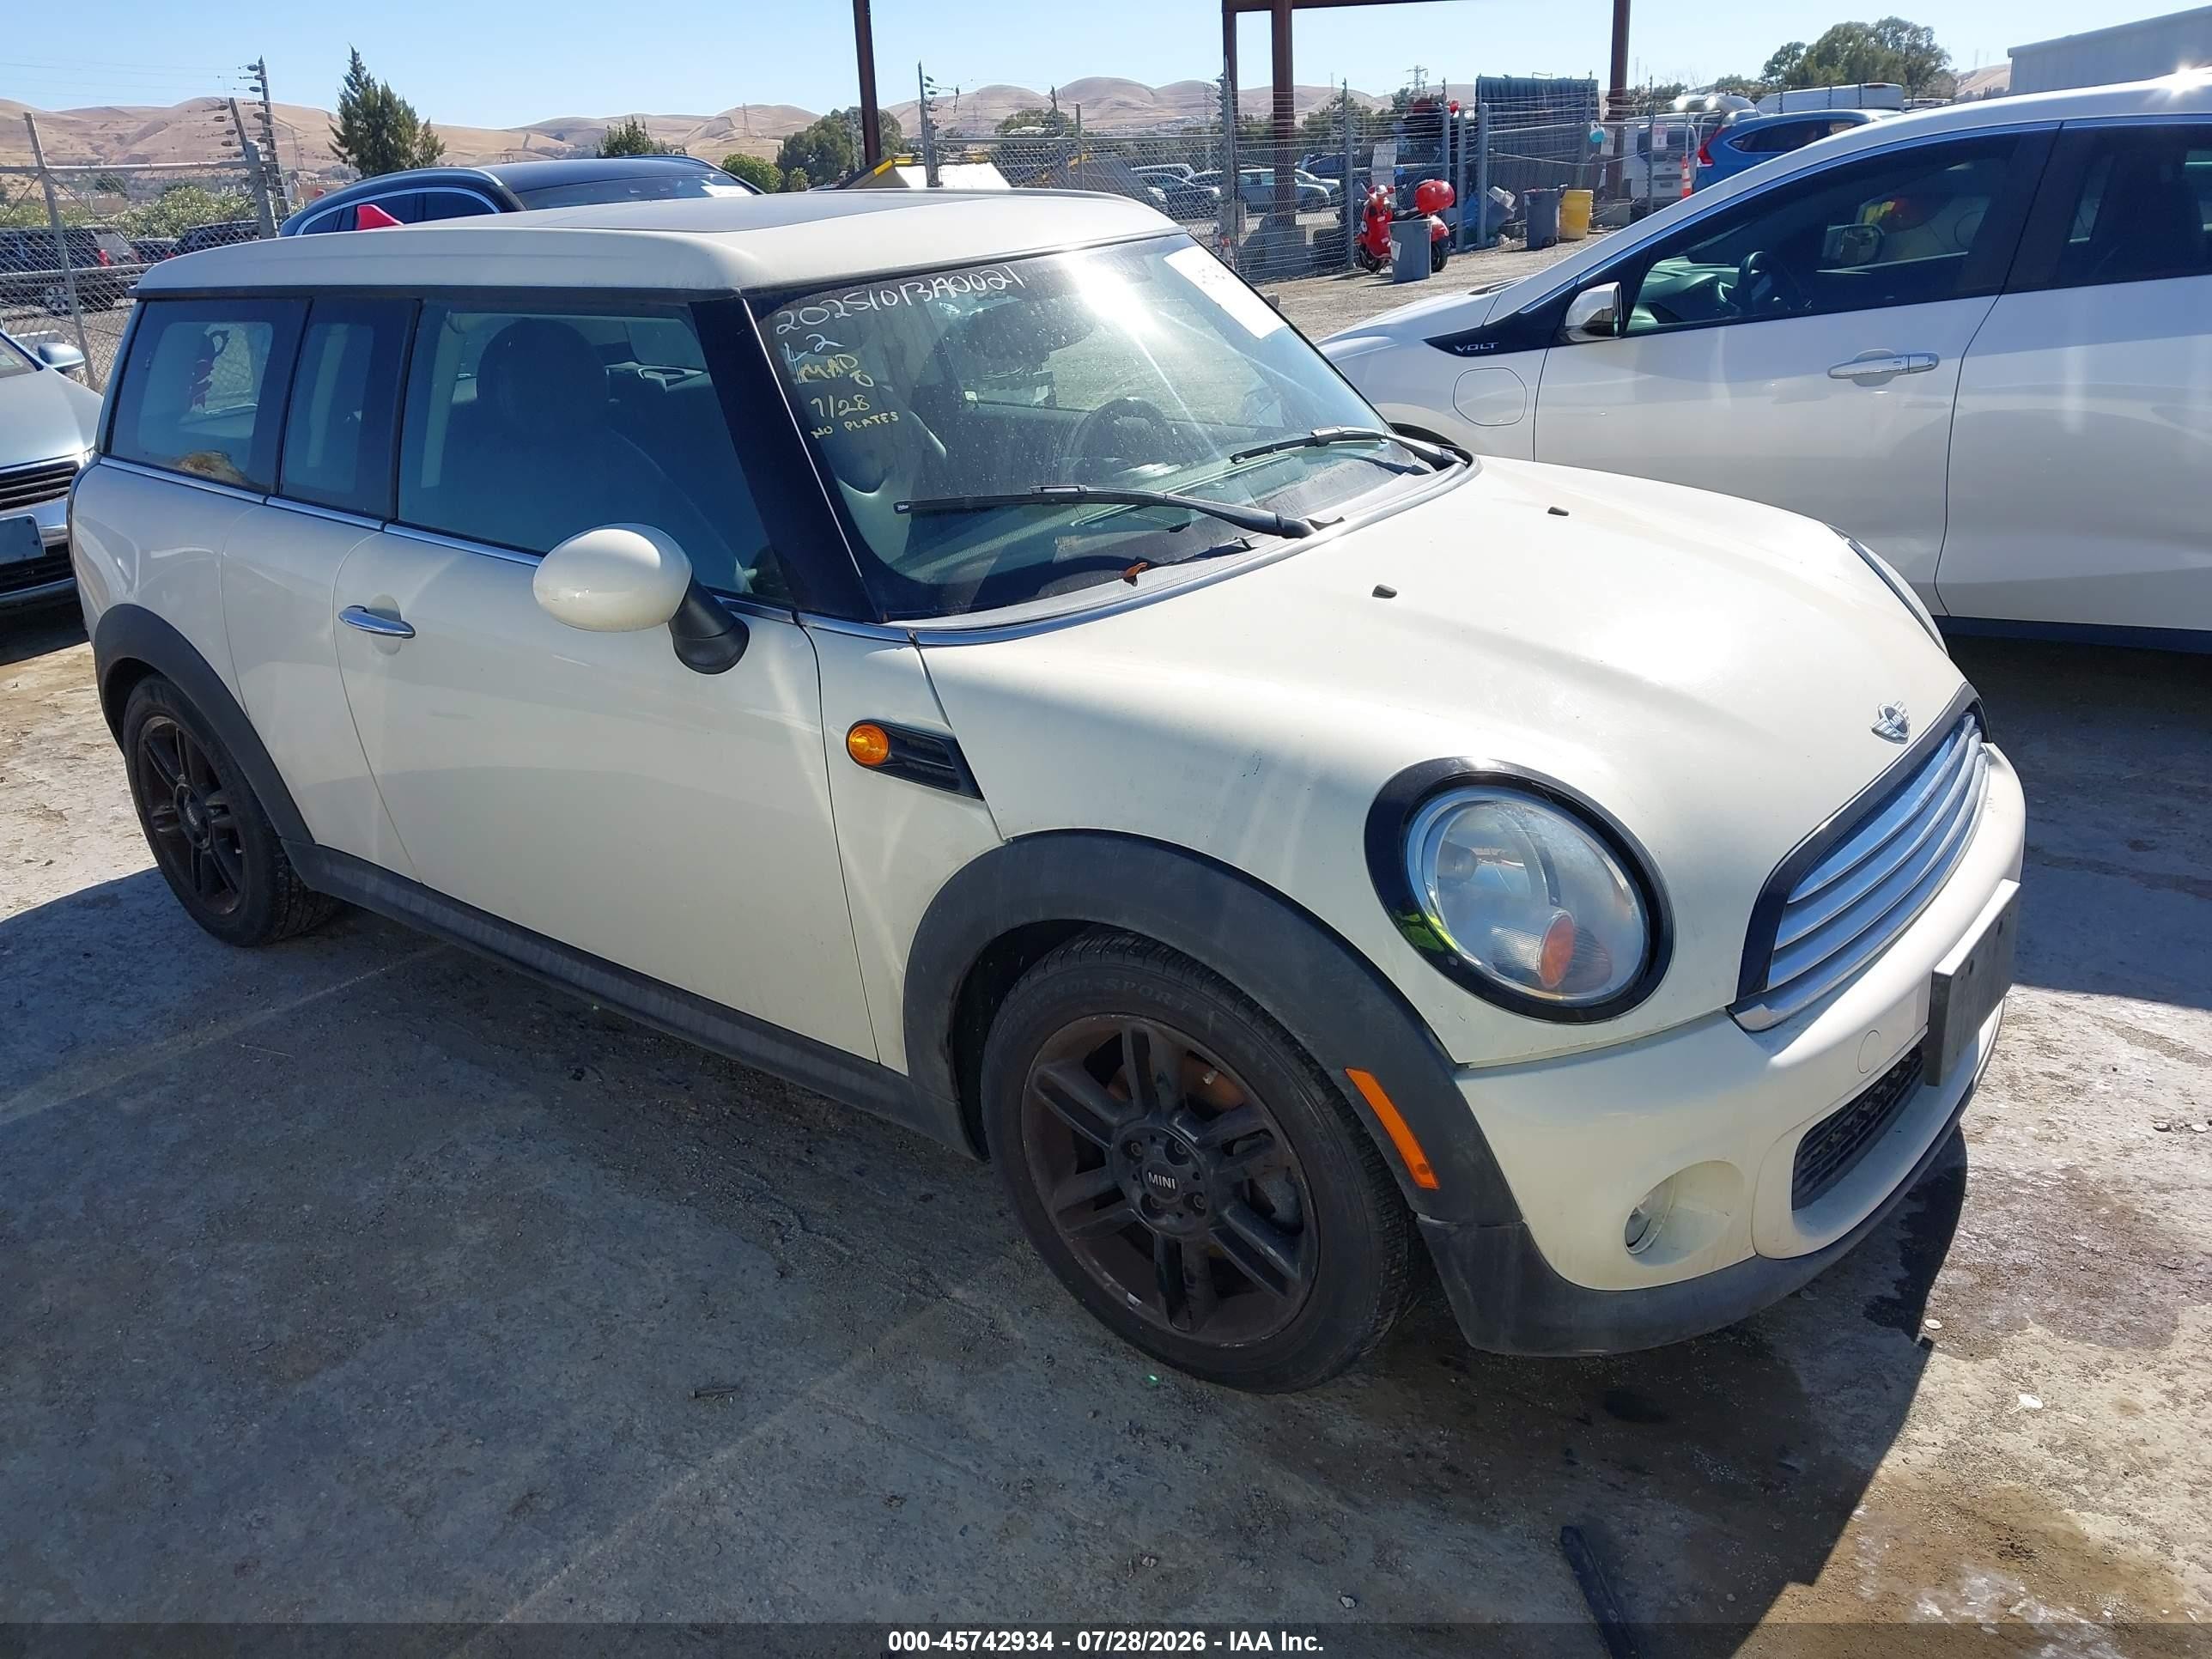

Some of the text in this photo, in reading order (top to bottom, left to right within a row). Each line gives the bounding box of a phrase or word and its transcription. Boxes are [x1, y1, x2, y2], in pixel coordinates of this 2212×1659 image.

[1455, 342, 1499, 353] VOLT
[811, 412, 899, 439] NO PLATES
[1148, 1171, 1176, 1189] MINI
